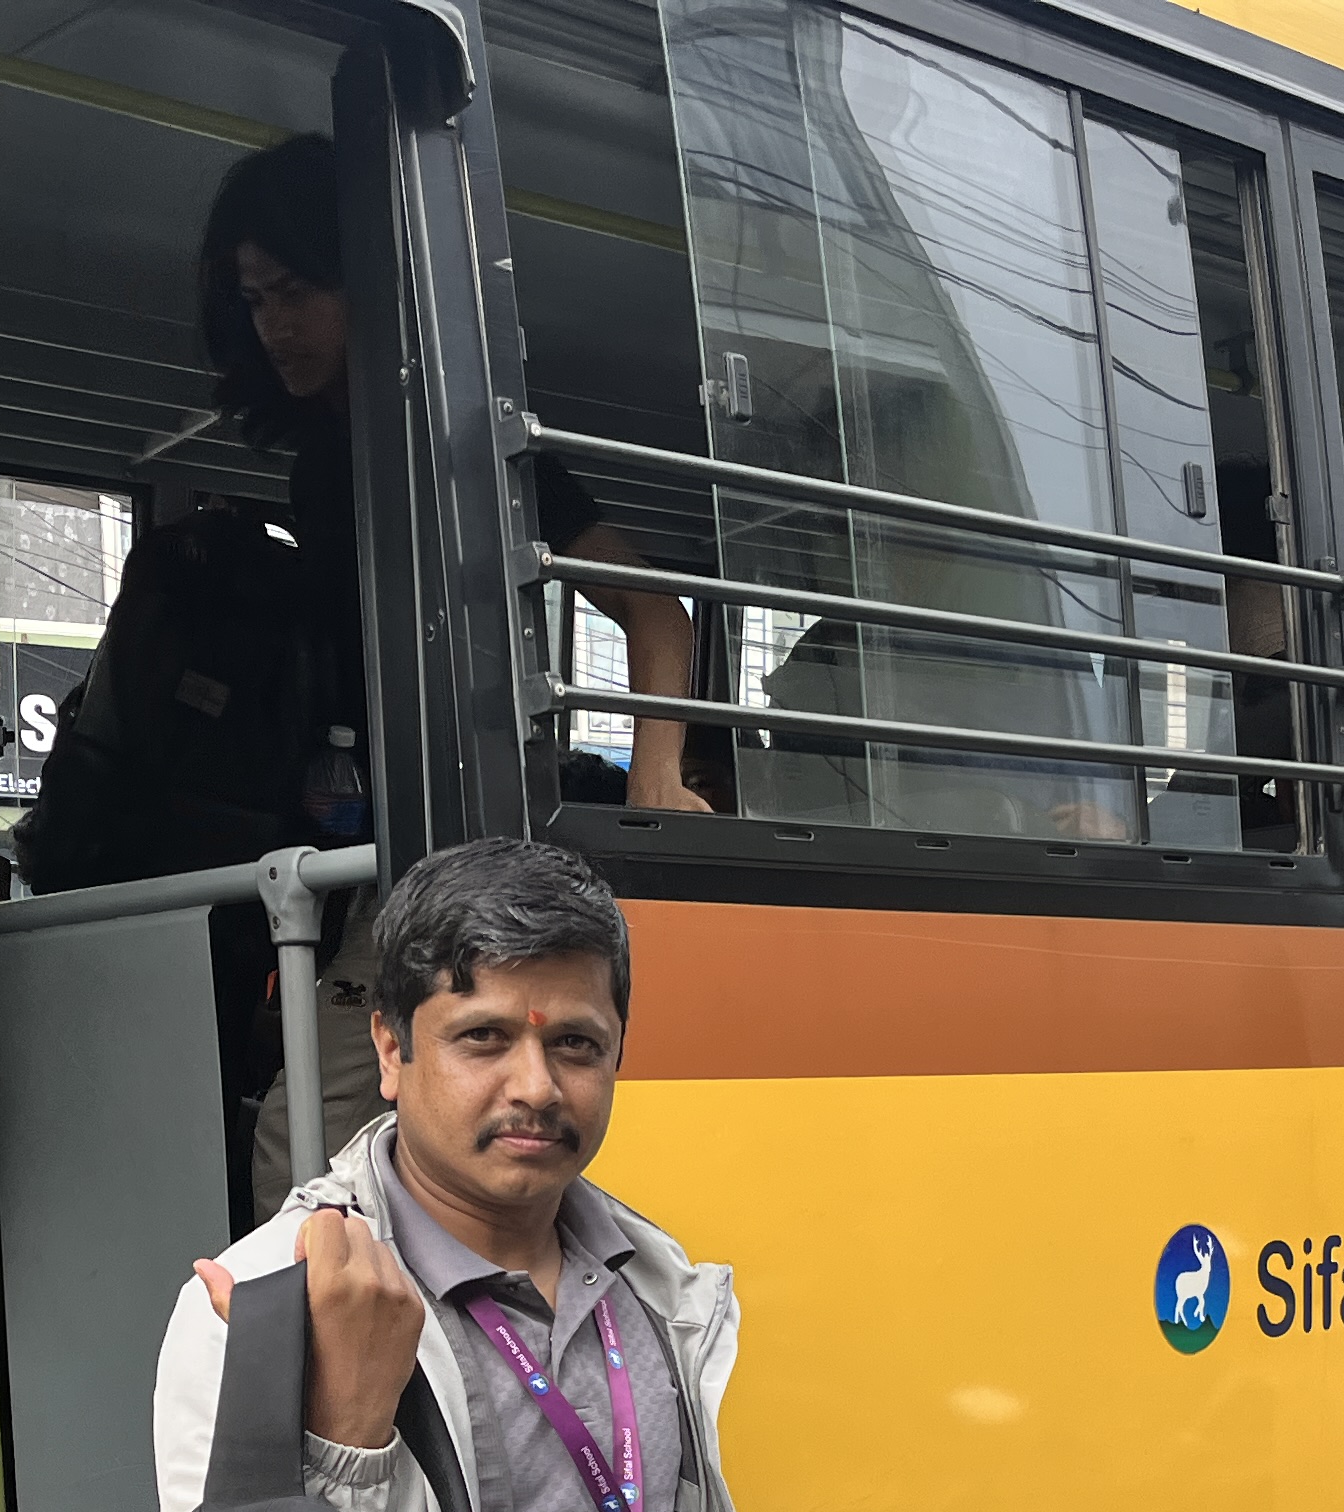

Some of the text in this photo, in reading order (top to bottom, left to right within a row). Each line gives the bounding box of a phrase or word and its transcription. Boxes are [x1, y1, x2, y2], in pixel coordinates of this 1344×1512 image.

[19, 693, 57, 753] S
[495, 1325, 534, 1374] Sifal School
[580, 1445, 611, 1495] Sifal School
[621, 1427, 634, 1481] Sifal School
